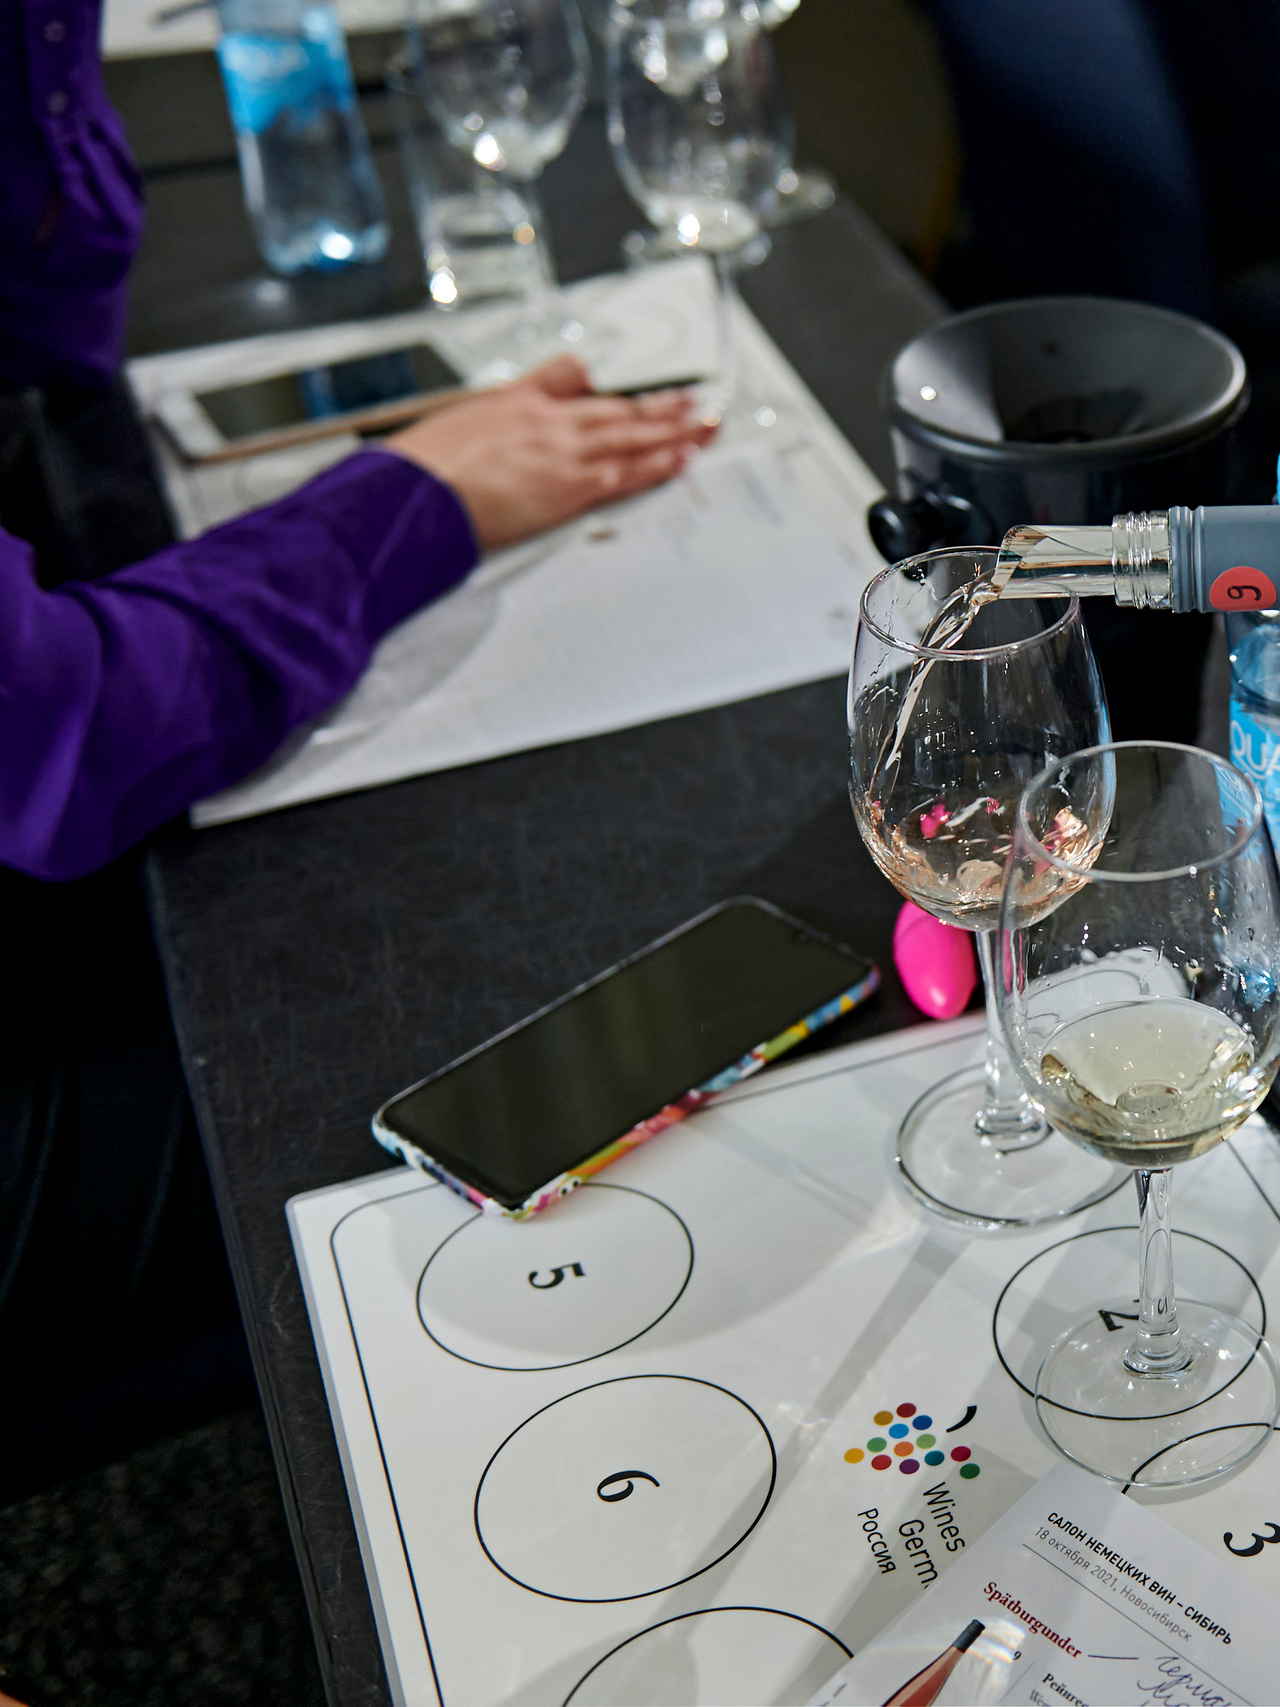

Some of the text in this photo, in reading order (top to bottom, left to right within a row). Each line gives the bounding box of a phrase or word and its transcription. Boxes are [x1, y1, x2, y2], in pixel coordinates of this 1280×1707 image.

[528, 1262, 587, 1290] 5
[923, 1481, 966, 1553] Wines
[898, 1518, 939, 1590] Germ
[1035, 1526, 1193, 1642] 18 октября 2021, Новосибирск
[1047, 1512, 1087, 1542] САЛОН
[1085, 1537, 1151, 1586] НЕМЕЦКИХ
[1148, 1580, 1177, 1604] ВИН
[1184, 1606, 1232, 1645] СИБИРЬ
[983, 1581, 1082, 1659] Spätburgunder
[1012, 1650, 1022, 1661] 9
